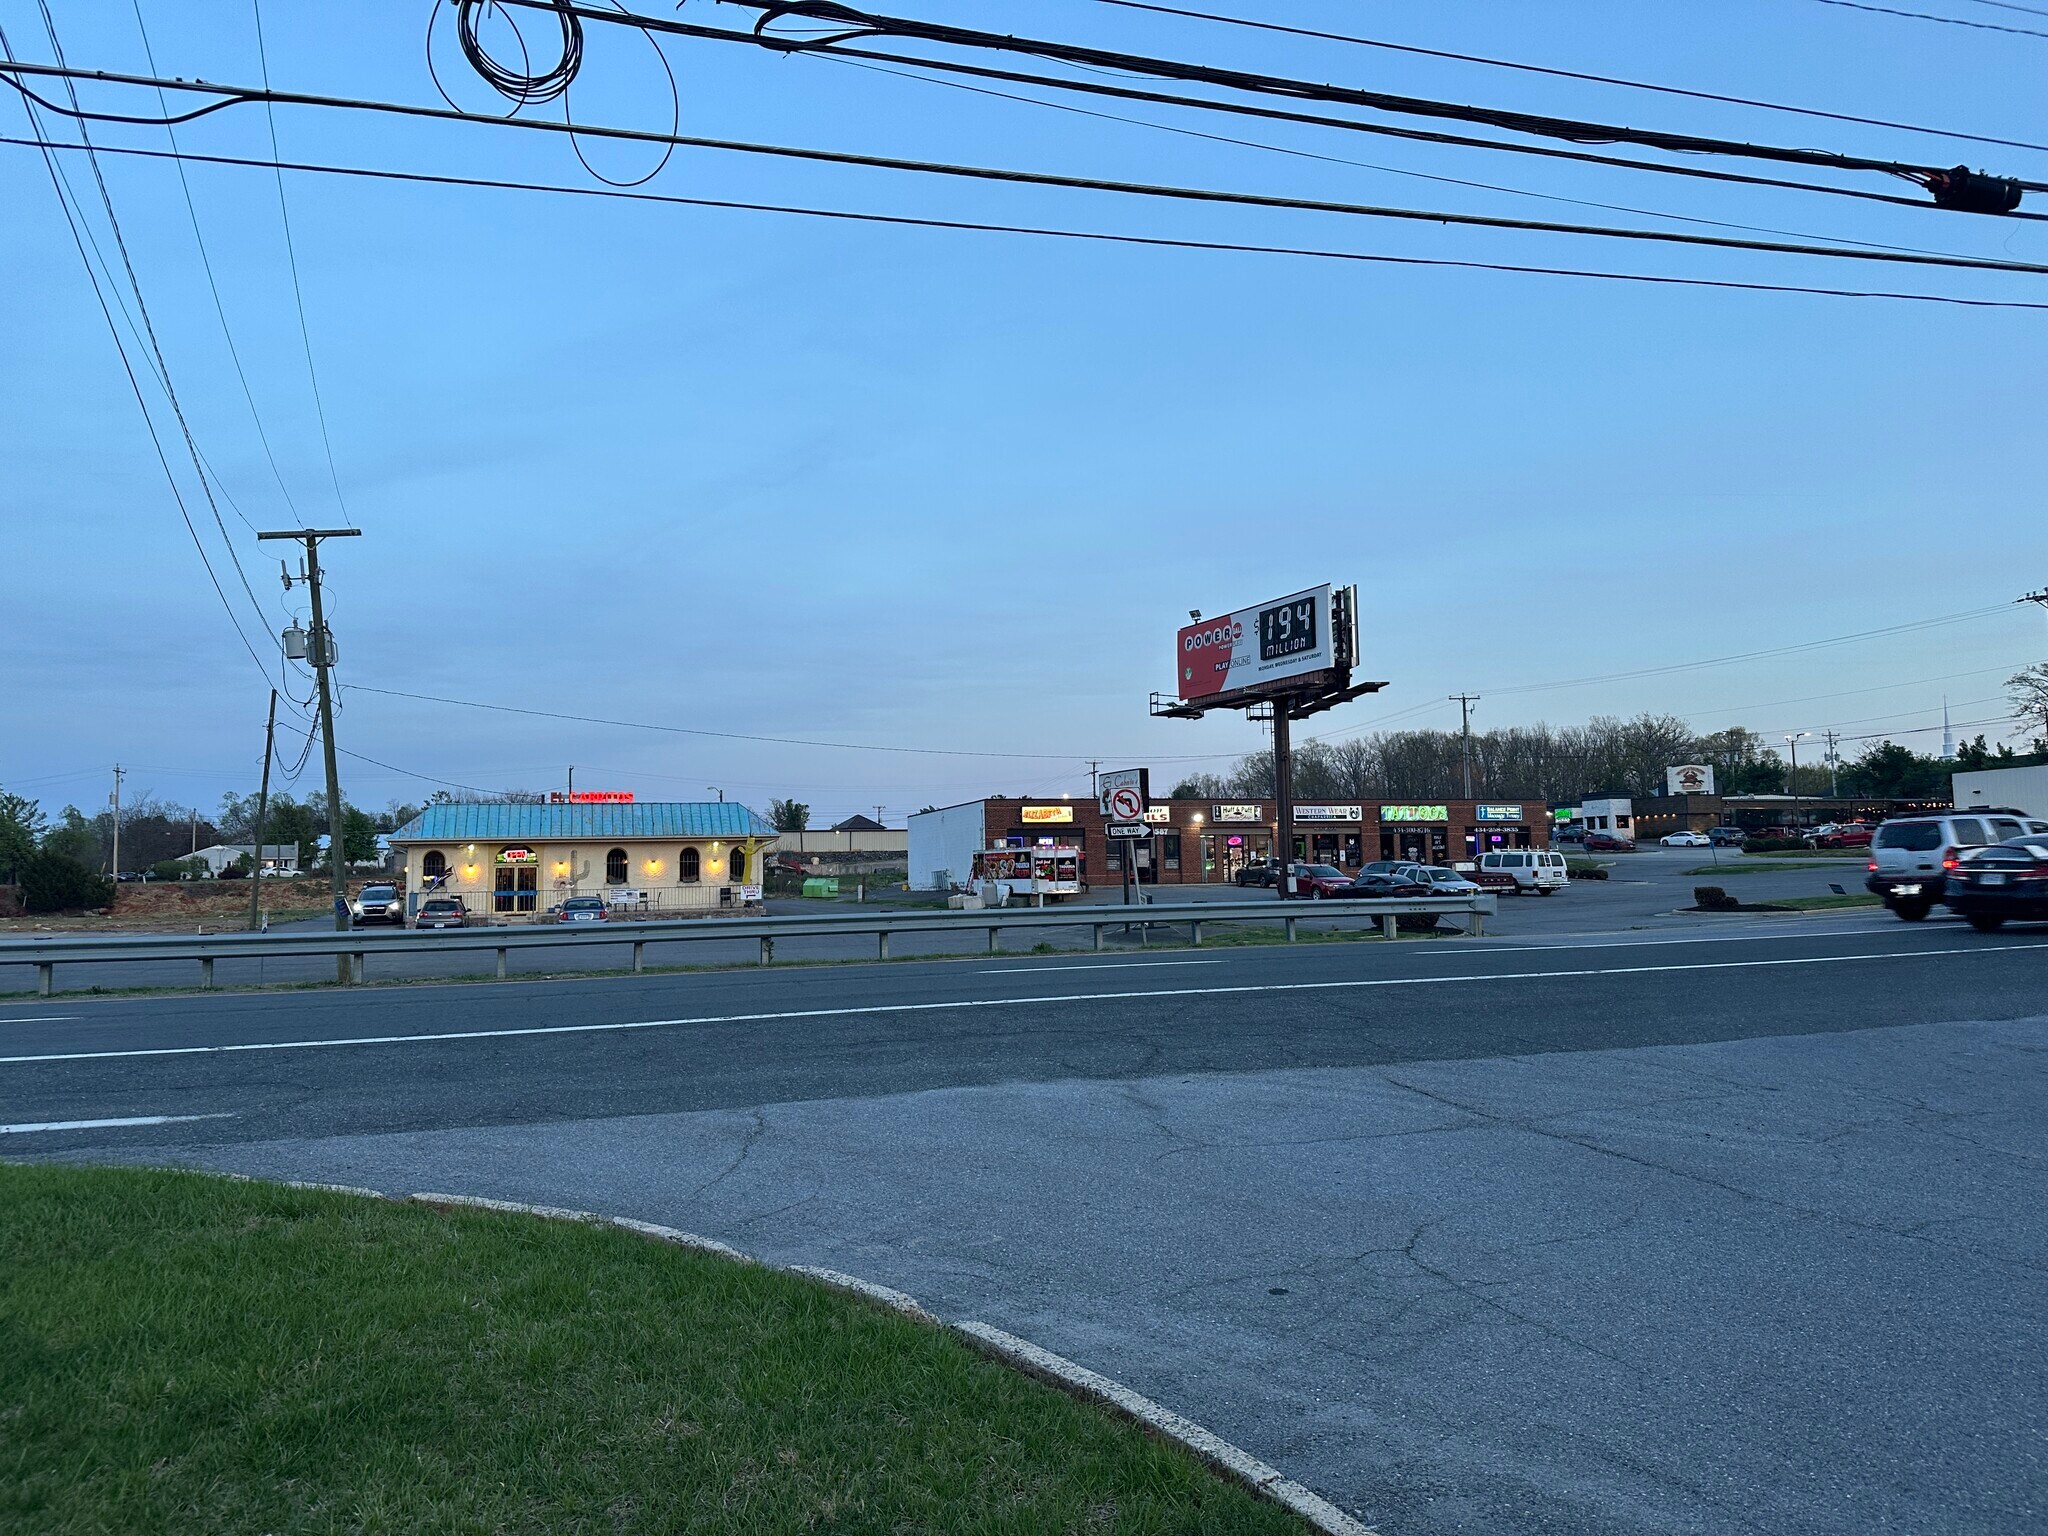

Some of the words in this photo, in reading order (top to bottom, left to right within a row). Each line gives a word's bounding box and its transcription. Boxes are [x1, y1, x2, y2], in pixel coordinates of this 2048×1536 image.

[1266, 636, 1306, 657] MILLION
[1302, 652, 1322, 662] SATURDAY
[1215, 661, 1229, 671] PLAY
[1381, 806, 1447, 821] TATTOOS
[1112, 827, 1126, 835] ONE
